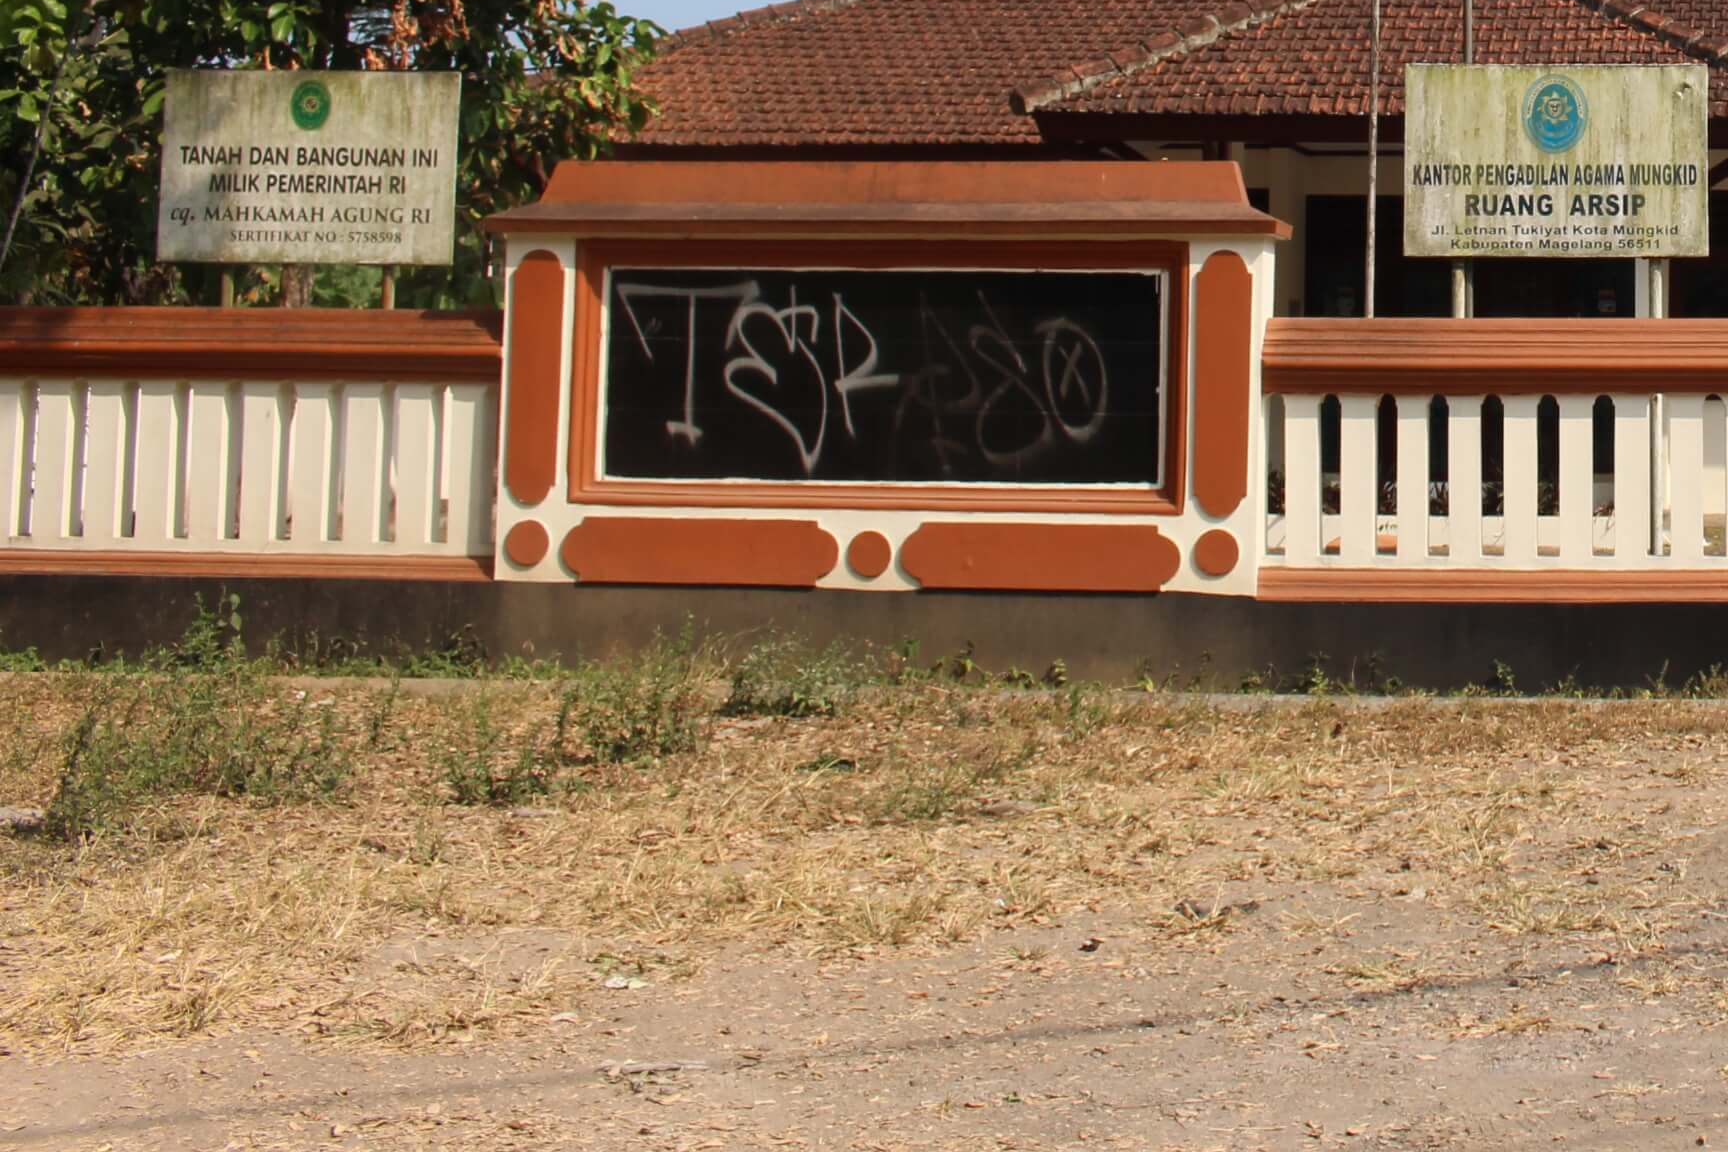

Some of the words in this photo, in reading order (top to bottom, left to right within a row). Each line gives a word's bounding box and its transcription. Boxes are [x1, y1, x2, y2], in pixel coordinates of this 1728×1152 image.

[180, 146, 242, 165] TANAH
[250, 147, 289, 166] DAN
[296, 147, 405, 167] BANGUNAN
[412, 149, 438, 167] INI
[208, 174, 259, 193] MILIK
[266, 175, 382, 194] PEMERINTAH
[389, 176, 406, 195] RI
[1413, 164, 1471, 186] KANTOR
[1475, 164, 1569, 186] PENGADILAN
[1573, 164, 1625, 186] AGAMA
[1629, 164, 1698, 186] MUNGKID
[203, 206, 324, 223] MAHKAMAH
[330, 207, 404, 224] AGUNG
[411, 208, 431, 224] RI
[1464, 194, 1553, 217] RUANG
[1569, 194, 1647, 217] ARSIP
[230, 230, 310, 242] SERTIFIKAT
[314, 231, 337, 243] NO
[348, 231, 402, 244] 5758598
[1431, 225, 1449, 235] Jl.
[1455, 225, 1507, 236] Letnan
[1511, 225, 1568, 239] Tukiyat
[1572, 225, 1608, 236] Kota
[1614, 225, 1679, 239] Mungkid
[1451, 239, 1533, 251] Kabupaten
[1539, 239, 1613, 252] Magelang
[1618, 238, 1661, 249] 56511
